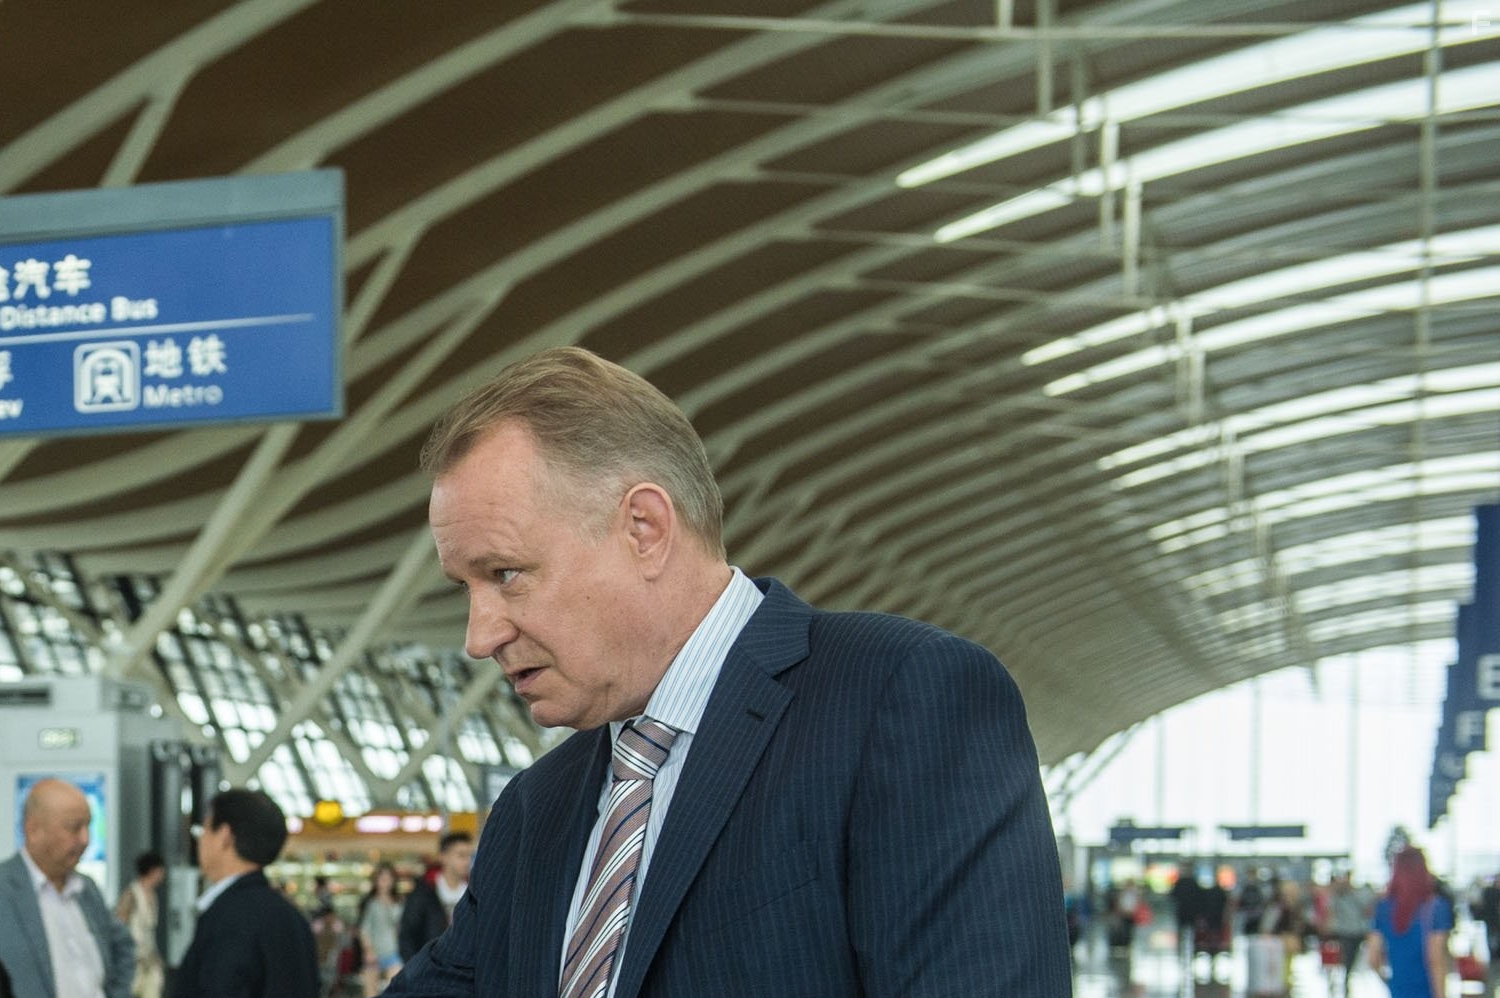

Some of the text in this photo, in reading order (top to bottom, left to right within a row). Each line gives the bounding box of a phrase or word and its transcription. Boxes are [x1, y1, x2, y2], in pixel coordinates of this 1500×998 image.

[0, 302, 106, 330] Distance
[111, 296, 159, 321] Bus
[143, 334, 227, 378] 地铁
[143, 384, 224, 407] Metro
